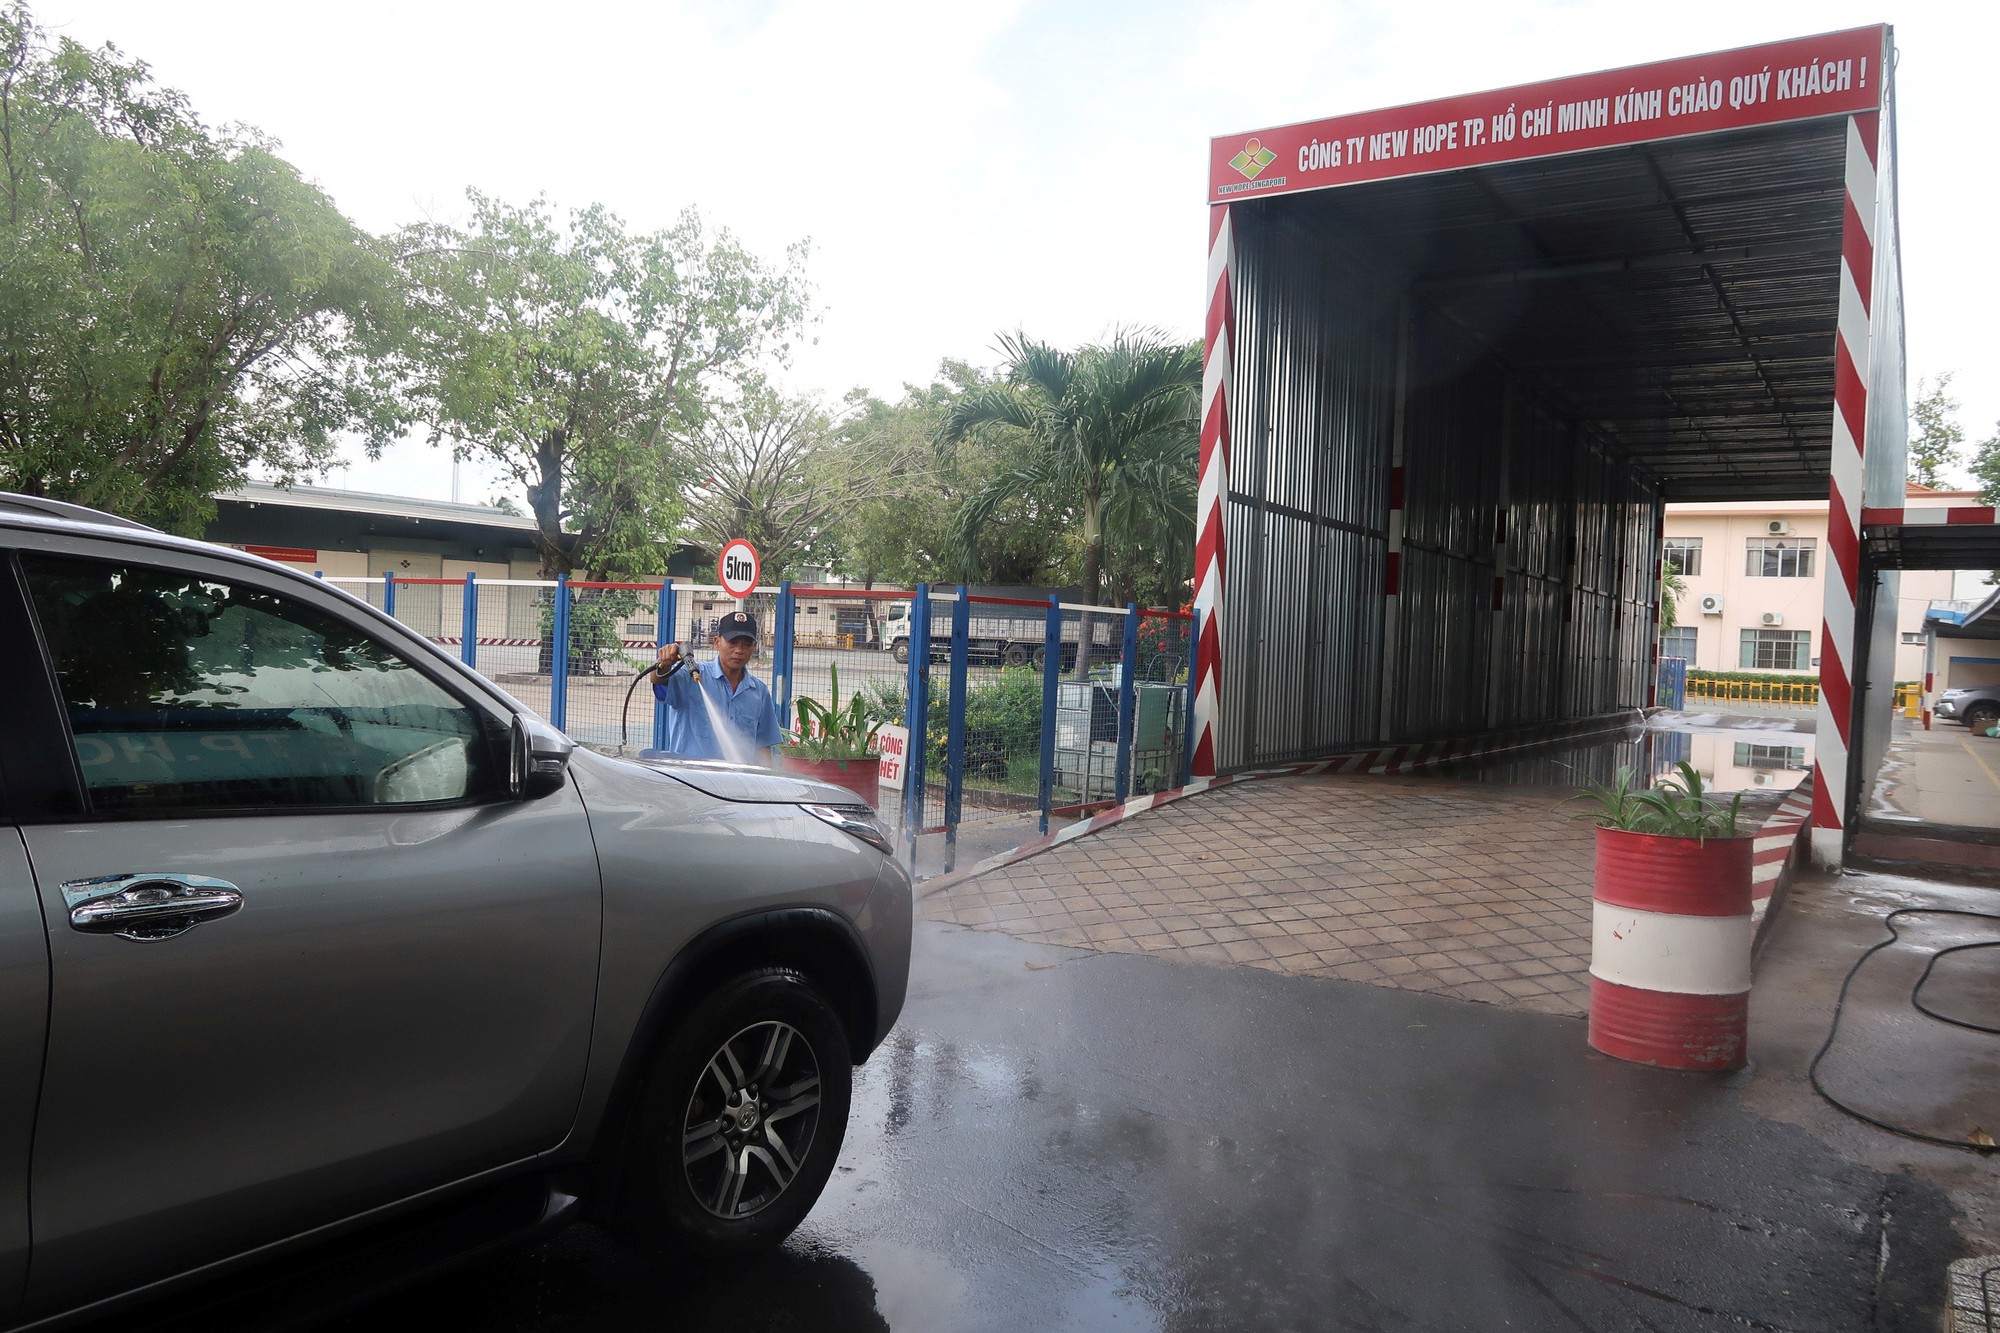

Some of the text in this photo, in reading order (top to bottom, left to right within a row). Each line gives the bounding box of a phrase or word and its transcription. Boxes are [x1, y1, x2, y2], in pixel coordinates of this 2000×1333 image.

[1298, 56, 1867, 172] CÔNG TY NEW HOPE TP. HỒ CHÍ MINH KÍNH CHÀO QUÝ KHÁCH !
[1218, 177, 1286, 195] NEW HOPE SINGAPORE
[726, 555, 753, 582] 5km
[880, 733, 903, 756] CÔNG
[879, 757, 900, 780] HẾT
